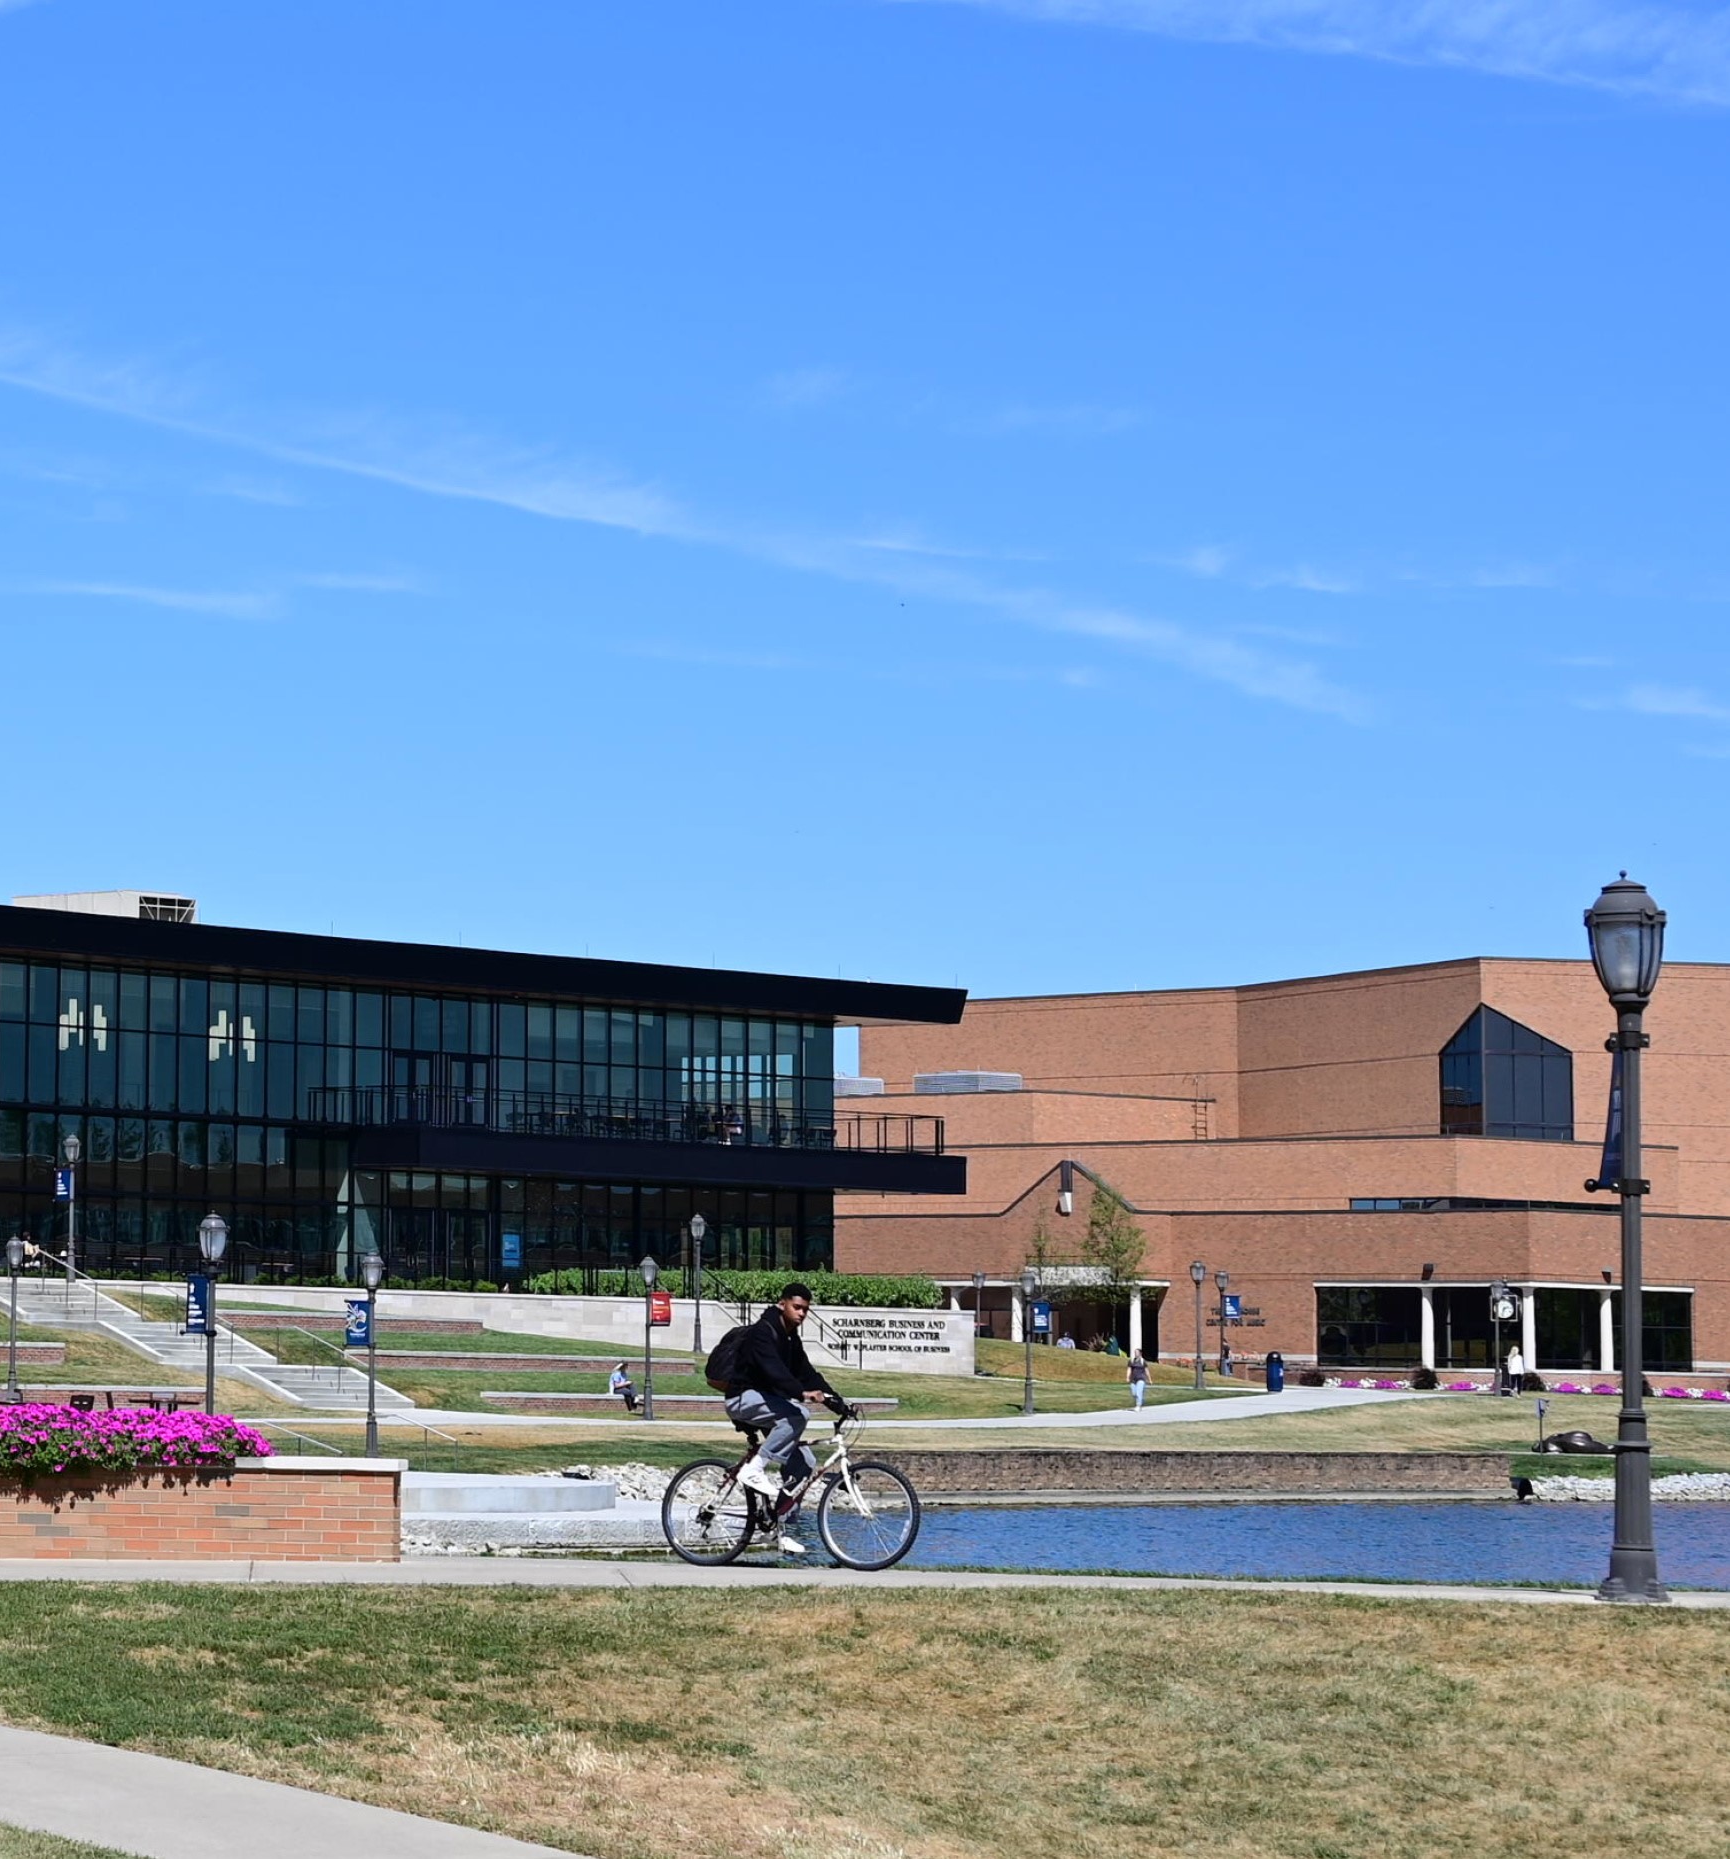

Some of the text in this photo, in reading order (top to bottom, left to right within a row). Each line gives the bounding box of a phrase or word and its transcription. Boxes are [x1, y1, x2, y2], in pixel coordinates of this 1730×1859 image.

[832, 1318, 946, 1330] SCHARNBERG BUSINESS AND
[838, 1328, 940, 1341] COMMUNICATION CENTER
